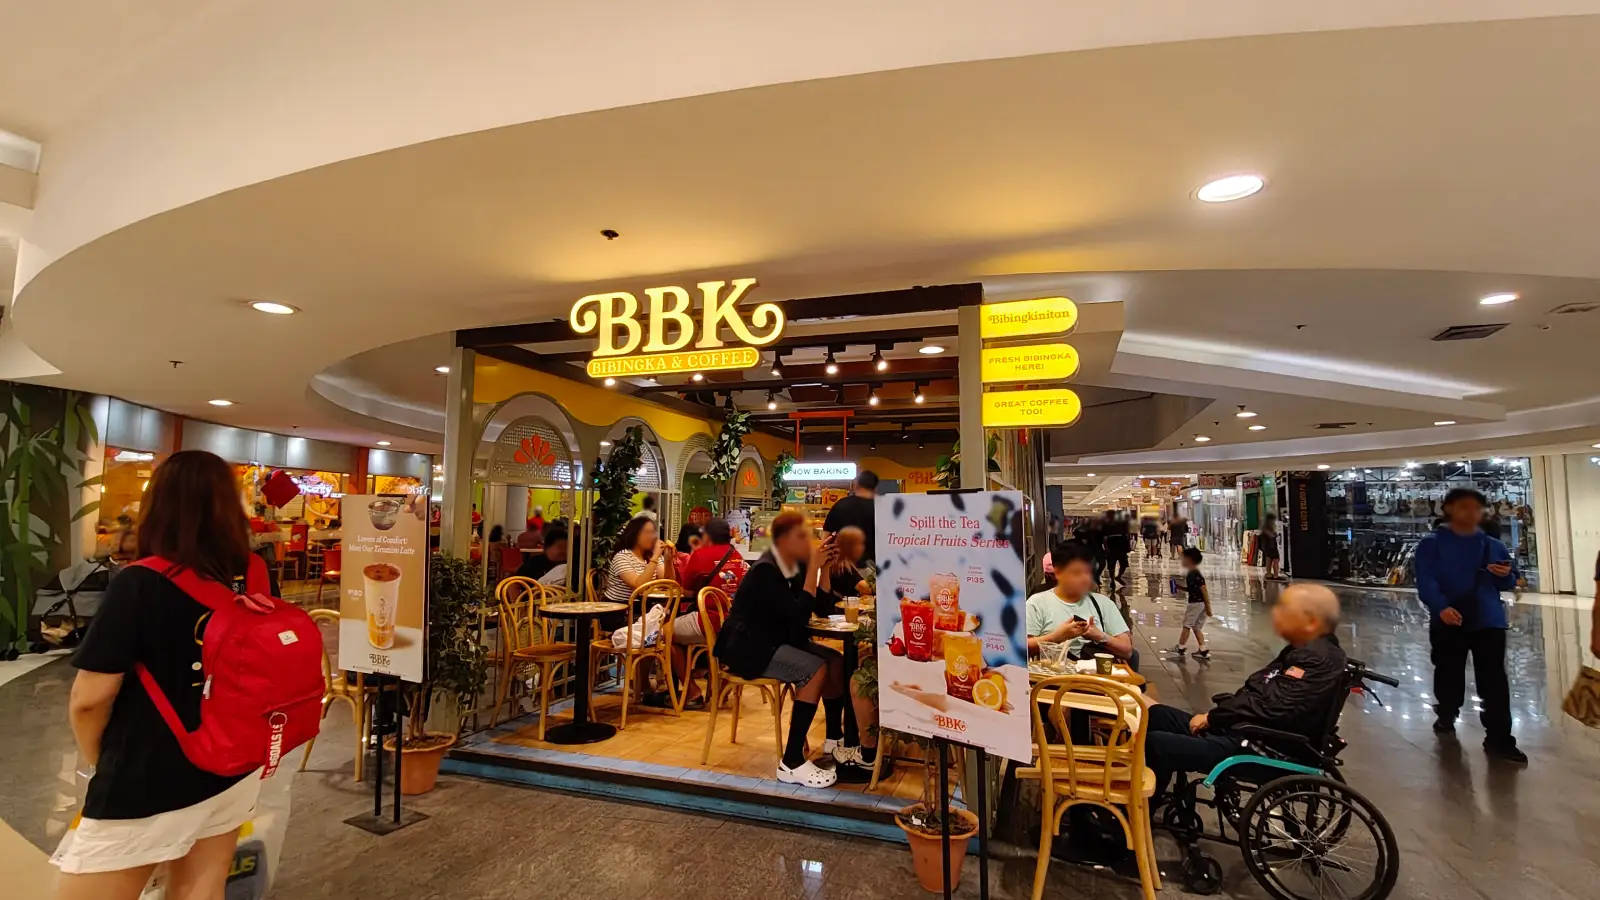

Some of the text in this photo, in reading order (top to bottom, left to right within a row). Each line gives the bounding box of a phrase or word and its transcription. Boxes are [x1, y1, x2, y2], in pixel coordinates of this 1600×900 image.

[570, 278, 784, 357] BBK
[988, 310, 1070, 324] Bibingkinitan
[591, 350, 754, 375] BIBINGKA & COFFEE
[988, 353, 1072, 364] FRESH BIBINGKA
[1014, 363, 1044, 371] HERE!
[994, 398, 1069, 409] GREAT COFFEE
[1020, 408, 1043, 416] TOO!
[790, 467, 849, 476] NOW BAKING
[909, 515, 980, 530] Spill the Tea
[887, 533, 1010, 549] Tropical Fruits Series
[369, 653, 391, 666] BBK
[934, 715, 967, 731] BBK
